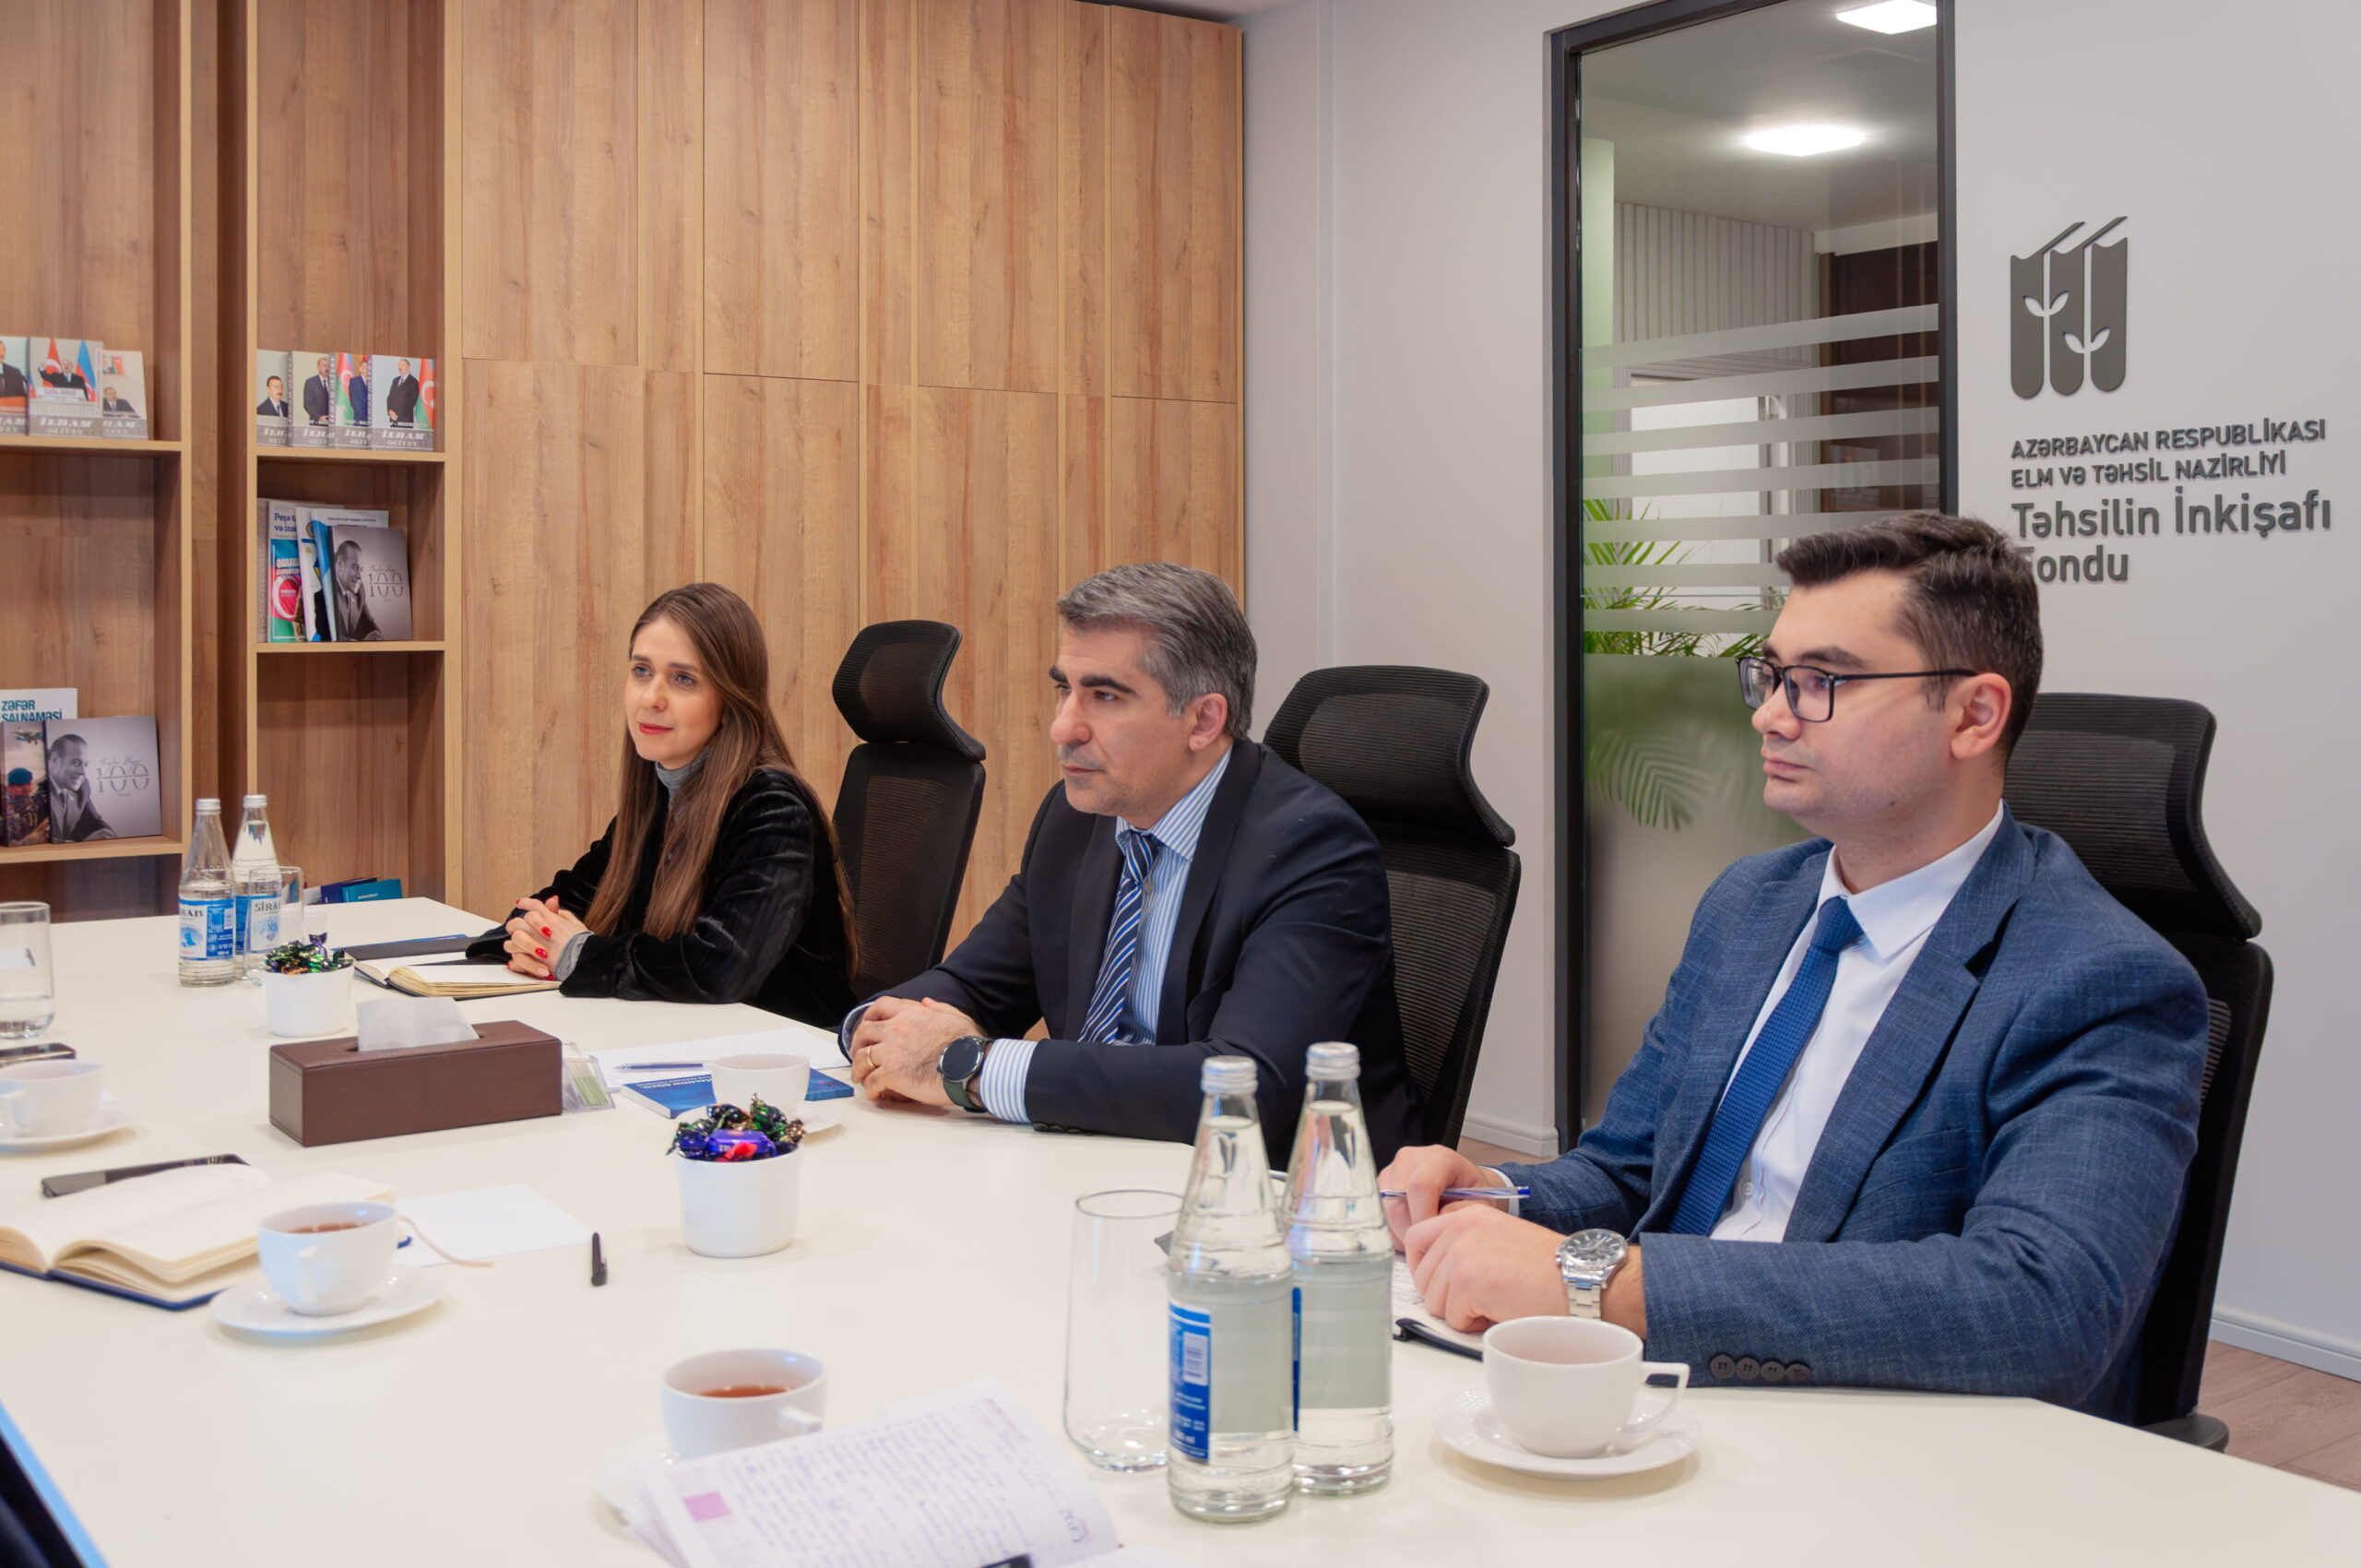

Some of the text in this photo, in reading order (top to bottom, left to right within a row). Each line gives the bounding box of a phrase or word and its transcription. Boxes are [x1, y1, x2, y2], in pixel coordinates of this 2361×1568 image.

[103, 420, 136, 428] HAM
[381, 429, 425, 440] İLHAM
[2011, 418, 2326, 459] AZƏRBAYCAN RESPUBLİKASI
[2011, 449, 2286, 488] ELM VƏ TƏHSİL NAZİRLİYİ
[2011, 485, 2331, 539] Təhsilin İnkişafı
[368, 572, 404, 598] 100
[2, 699, 35, 711] ZƏFƏR
[2, 708, 63, 722] SALNAMƏSİ
[96, 764, 149, 793] 100
[180, 908, 203, 918] RAB
